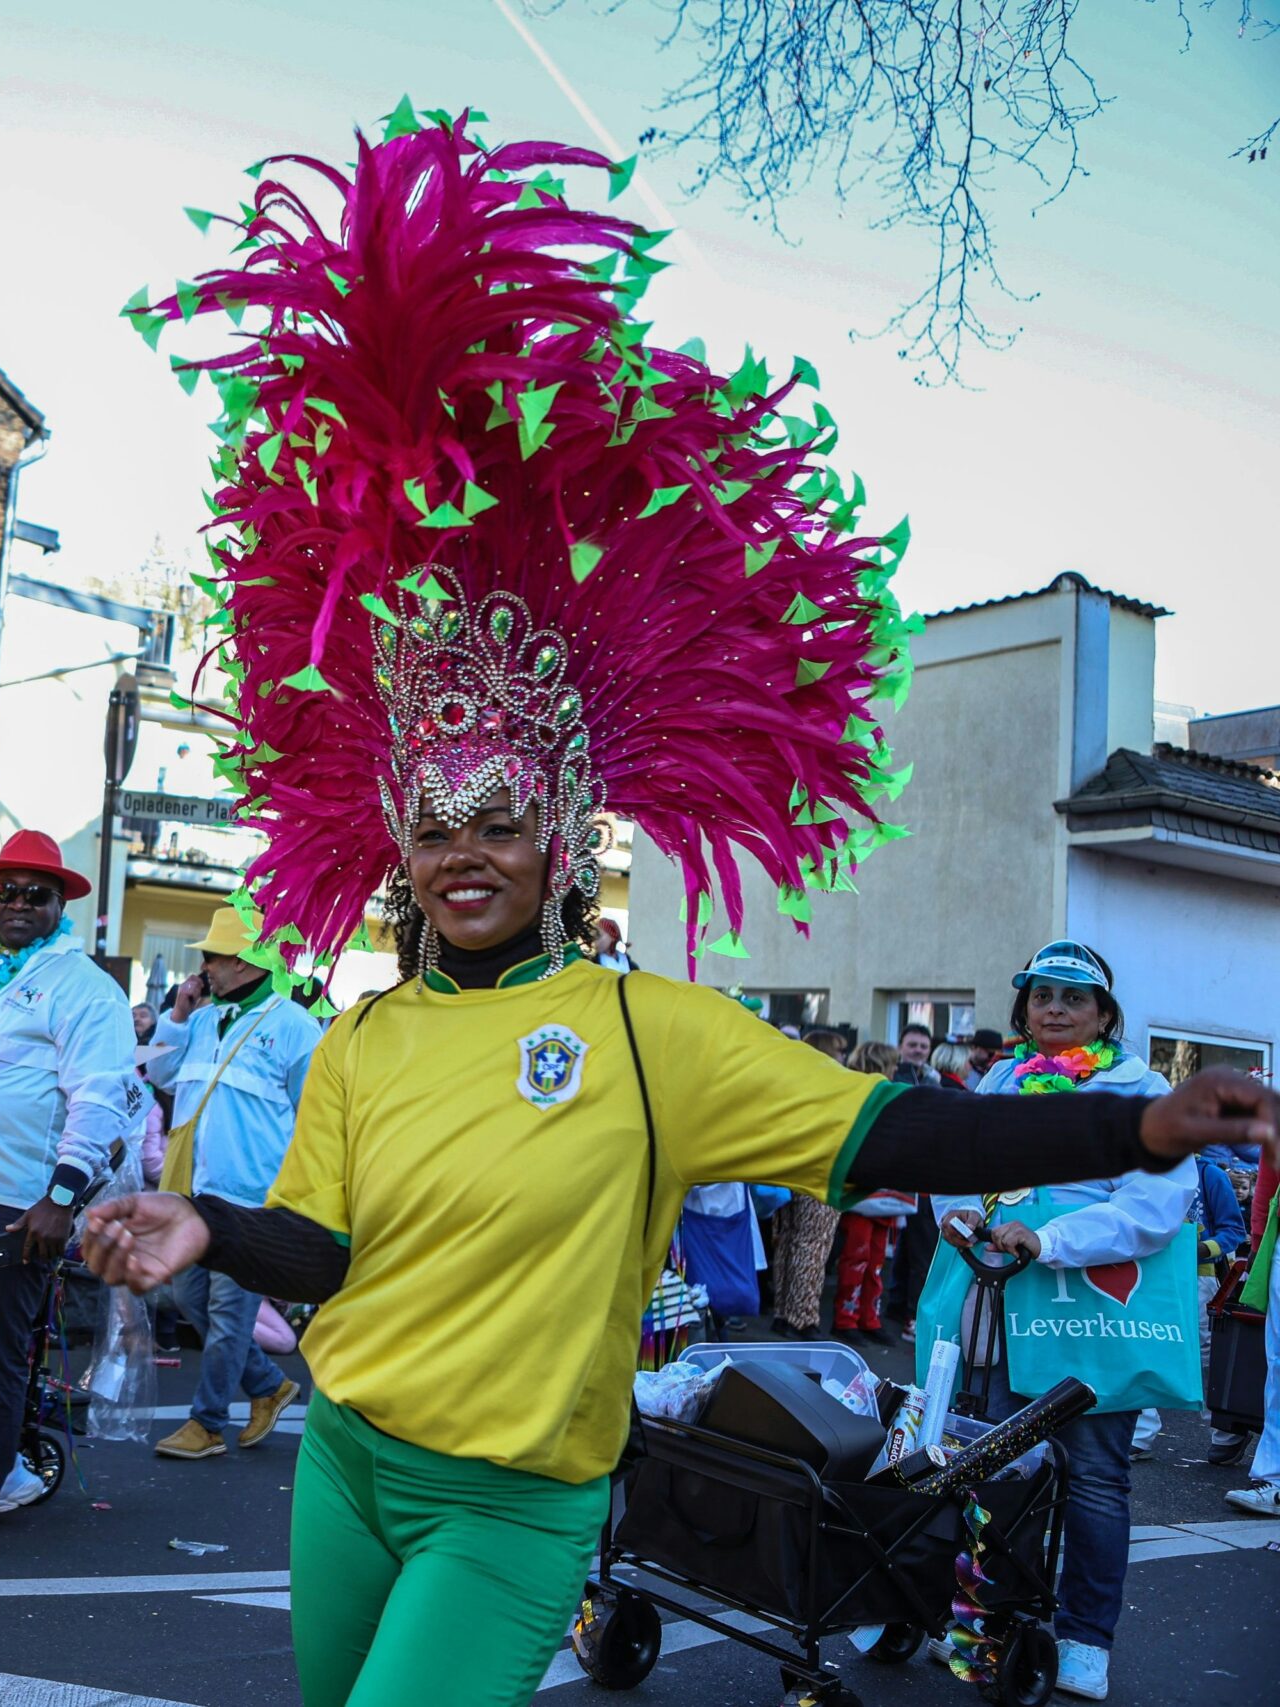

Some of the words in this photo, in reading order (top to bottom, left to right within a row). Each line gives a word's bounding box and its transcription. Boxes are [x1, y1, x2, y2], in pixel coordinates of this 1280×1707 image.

[123, 793, 198, 816] Opladener
[1051, 1268, 1076, 1303] I
[1008, 1312, 1184, 1343] Leverkusen
